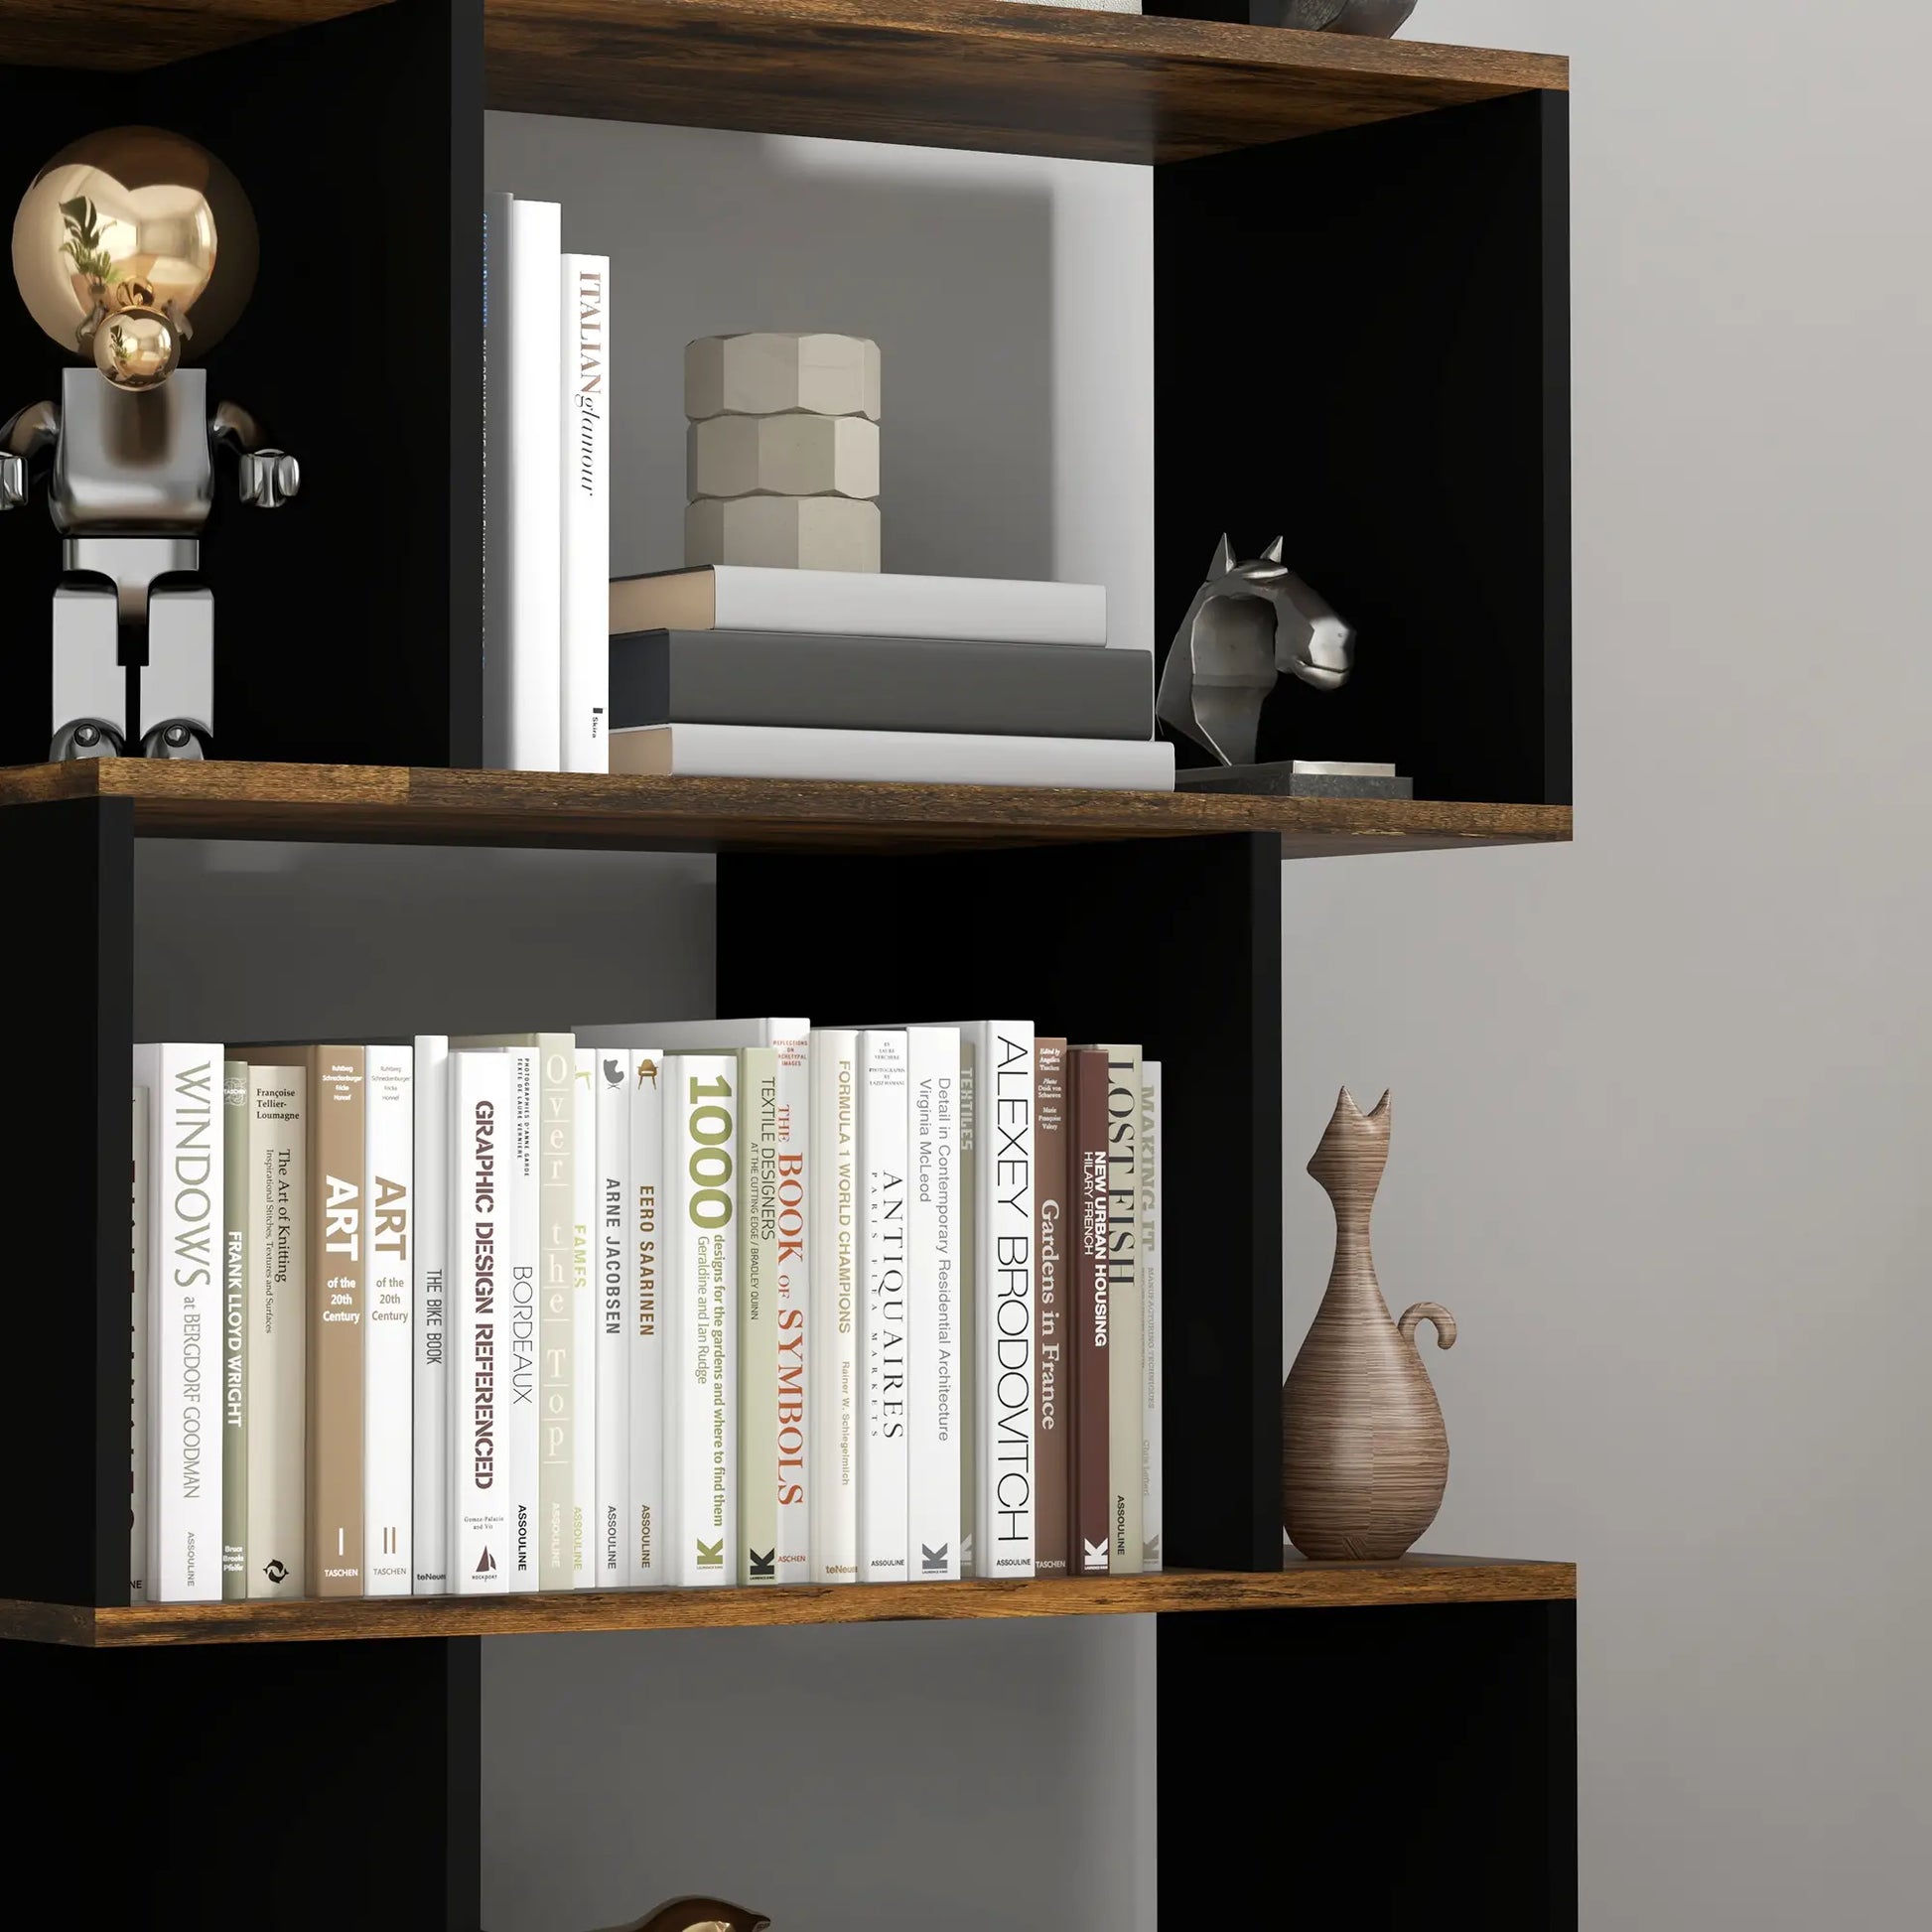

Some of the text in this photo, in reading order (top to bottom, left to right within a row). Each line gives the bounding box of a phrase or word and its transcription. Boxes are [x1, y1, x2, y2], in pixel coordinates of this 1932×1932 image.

[575, 271, 601, 496] ITALIAN glamour
[256, 1088, 296, 1098] Françoise
[257, 1111, 300, 1120] Loumagne
[517, 1084, 522, 1092] DE
[839, 1060, 851, 1144] FORMULA
[961, 1068, 973, 1151] TEXTILES
[264, 1149, 274, 1202] Inspirational
[750, 1142, 759, 1155] AT
[750, 1158, 759, 1174] THE
[761, 1077, 775, 1240] TEXTILE DESIGNERS
[917, 1079, 932, 1202] Virginia McLeod
[1108, 1059, 1135, 1286] LOST FISH
[1142, 1085, 1155, 1252] MAKING IT
[265, 1204, 274, 1239] Stitches,
[275, 1149, 290, 1283] The Art of Knitting
[326, 1175, 358, 1261] ART
[375, 1175, 406, 1260] ART
[750, 1177, 759, 1214] CUTTING
[750, 1216, 759, 1239] EDGE
[839, 1163, 851, 1226] WORLD
[1084, 1151, 1093, 1255] HILARY FRENCH
[175, 1060, 211, 1499] WINDOWS at BERGDORF GOODMAN
[327, 1278, 356, 1289] of the
[376, 1278, 404, 1288] of the
[549, 1223, 564, 1312] the
[606, 1178, 620, 1334] ARNE JACOBSEN
[640, 1185, 654, 1336] EERO SAARINEN
[750, 1248, 759, 1289] BRADLEY
[839, 1231, 851, 1334] CHAMPIONS
[936, 1078, 951, 1441] Detail in Contemporary Residential Architecture
[997, 1035, 1029, 1541] ALEXEY BRODOVITCH
[1095, 1151, 1106, 1347] NEW URBAN HOUSING
[227, 1231, 242, 1428] FRANK LLOYD WRIGHT
[323, 1311, 360, 1324] Century
[331, 1294, 352, 1305] 20th
[372, 1311, 408, 1323] Century
[380, 1294, 401, 1304] 20th
[426, 1269, 442, 1365] THE BIKE BOOK
[475, 1100, 494, 1489] GRAPHIC DESIGN REFERENCED
[513, 1266, 533, 1404] BORDEAUX
[689, 1075, 732, 1526] 1000 designs for the gardens and where to find them
[695, 1236, 709, 1384] Geraldine and Ian Rudge
[750, 1291, 759, 1320] QUINN
[778, 1104, 804, 1505] THE BOOK OF SYMBOLS
[878, 1170, 903, 1438] ANTIQUAIRES
[1042, 1200, 1060, 1430] Gardens in France
[840, 1361, 850, 1485] Rainer W. Schlegelmilch
[518, 1505, 527, 1571] ASSOULINE
[551, 1503, 560, 1568] ASSOULINE
[574, 1507, 582, 1570] ASSOULINE
[608, 1505, 616, 1569] ASSOULINE
[642, 1505, 650, 1568] ASSOULINE
[778, 1555, 806, 1563] ASCHEN
[996, 1559, 1031, 1567] ASSOULINE
[1035, 1560, 1065, 1568] TASCHEN
[1117, 1495, 1125, 1556] ASSOULINE
[325, 1568, 358, 1577] TASCHEN
